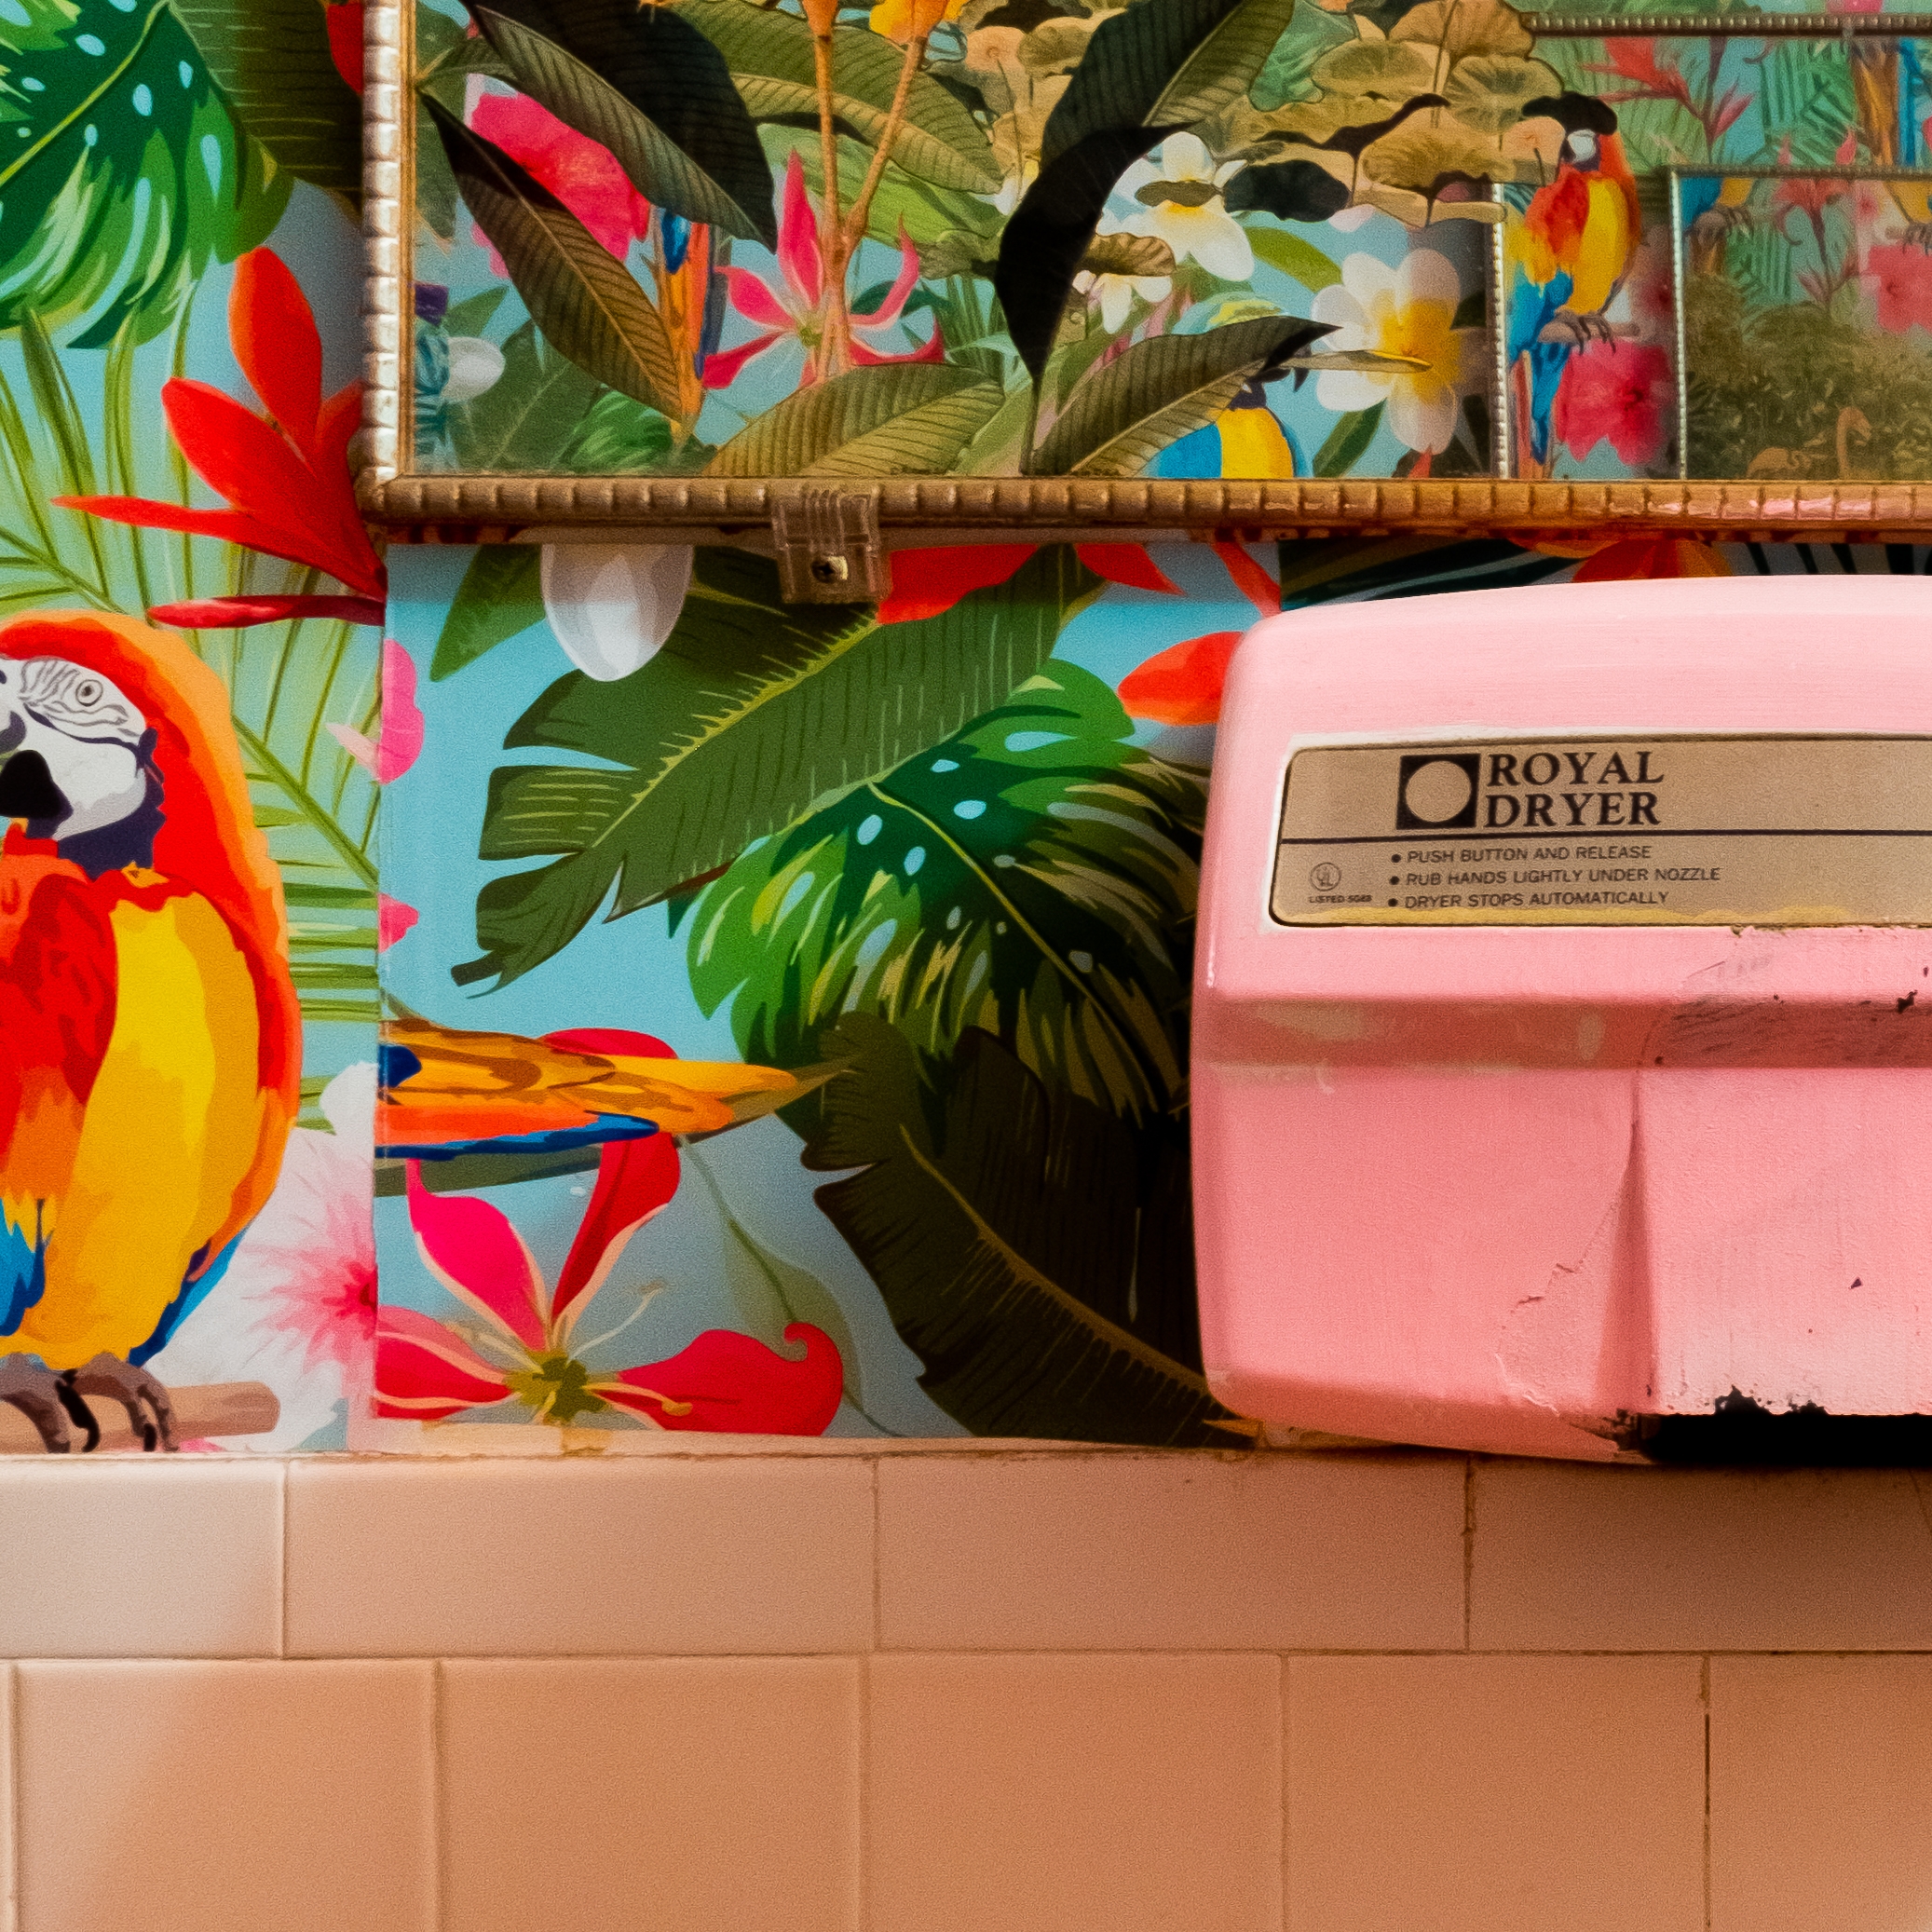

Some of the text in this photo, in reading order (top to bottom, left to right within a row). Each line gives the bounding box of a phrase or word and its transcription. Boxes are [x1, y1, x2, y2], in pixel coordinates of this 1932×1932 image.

[1489, 752, 1664, 786] ROYAL
[1485, 792, 1661, 827] DRYER
[1407, 845, 1652, 864] PUSH BUTTON AND RELEASE
[1406, 867, 1721, 885] RUB HANDS LIGHTLY UNDER NOZZLE
[1405, 891, 1669, 908] DRYER STOPS AUTOMATICALLY
